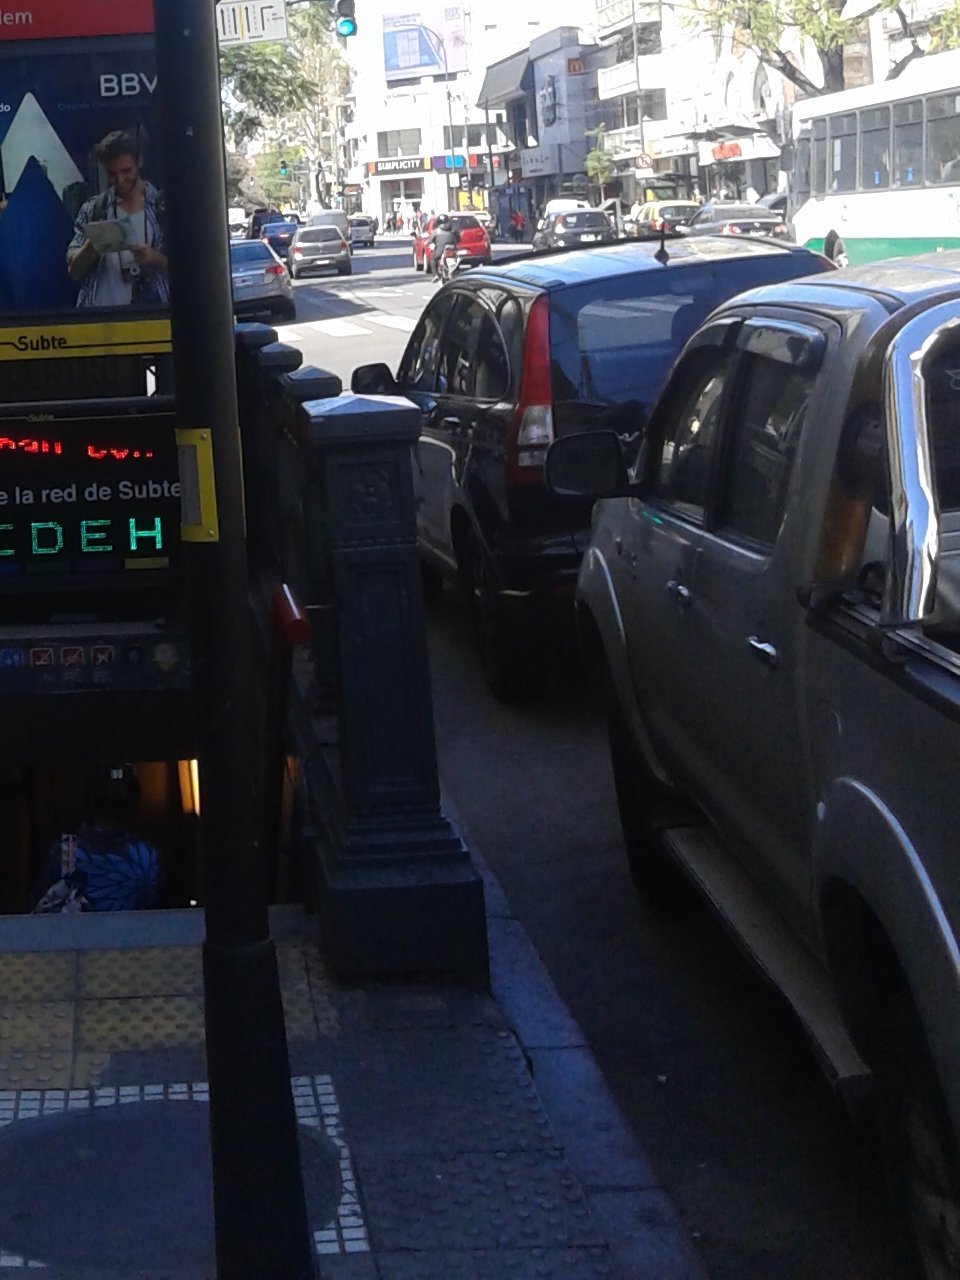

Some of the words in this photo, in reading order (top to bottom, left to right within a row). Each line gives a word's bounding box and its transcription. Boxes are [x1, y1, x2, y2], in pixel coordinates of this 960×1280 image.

[377, 160, 421, 171] SIMPLICITY
[18, 335, 67, 352] Subte
[15, 486, 34, 504] la
[42, 484, 77, 502] red
[84, 482, 112, 500] de
[119, 480, 181, 499] Subte
[31, 522, 64, 554] D
[80, 520, 113, 552] E
[129, 517, 161, 550] H
